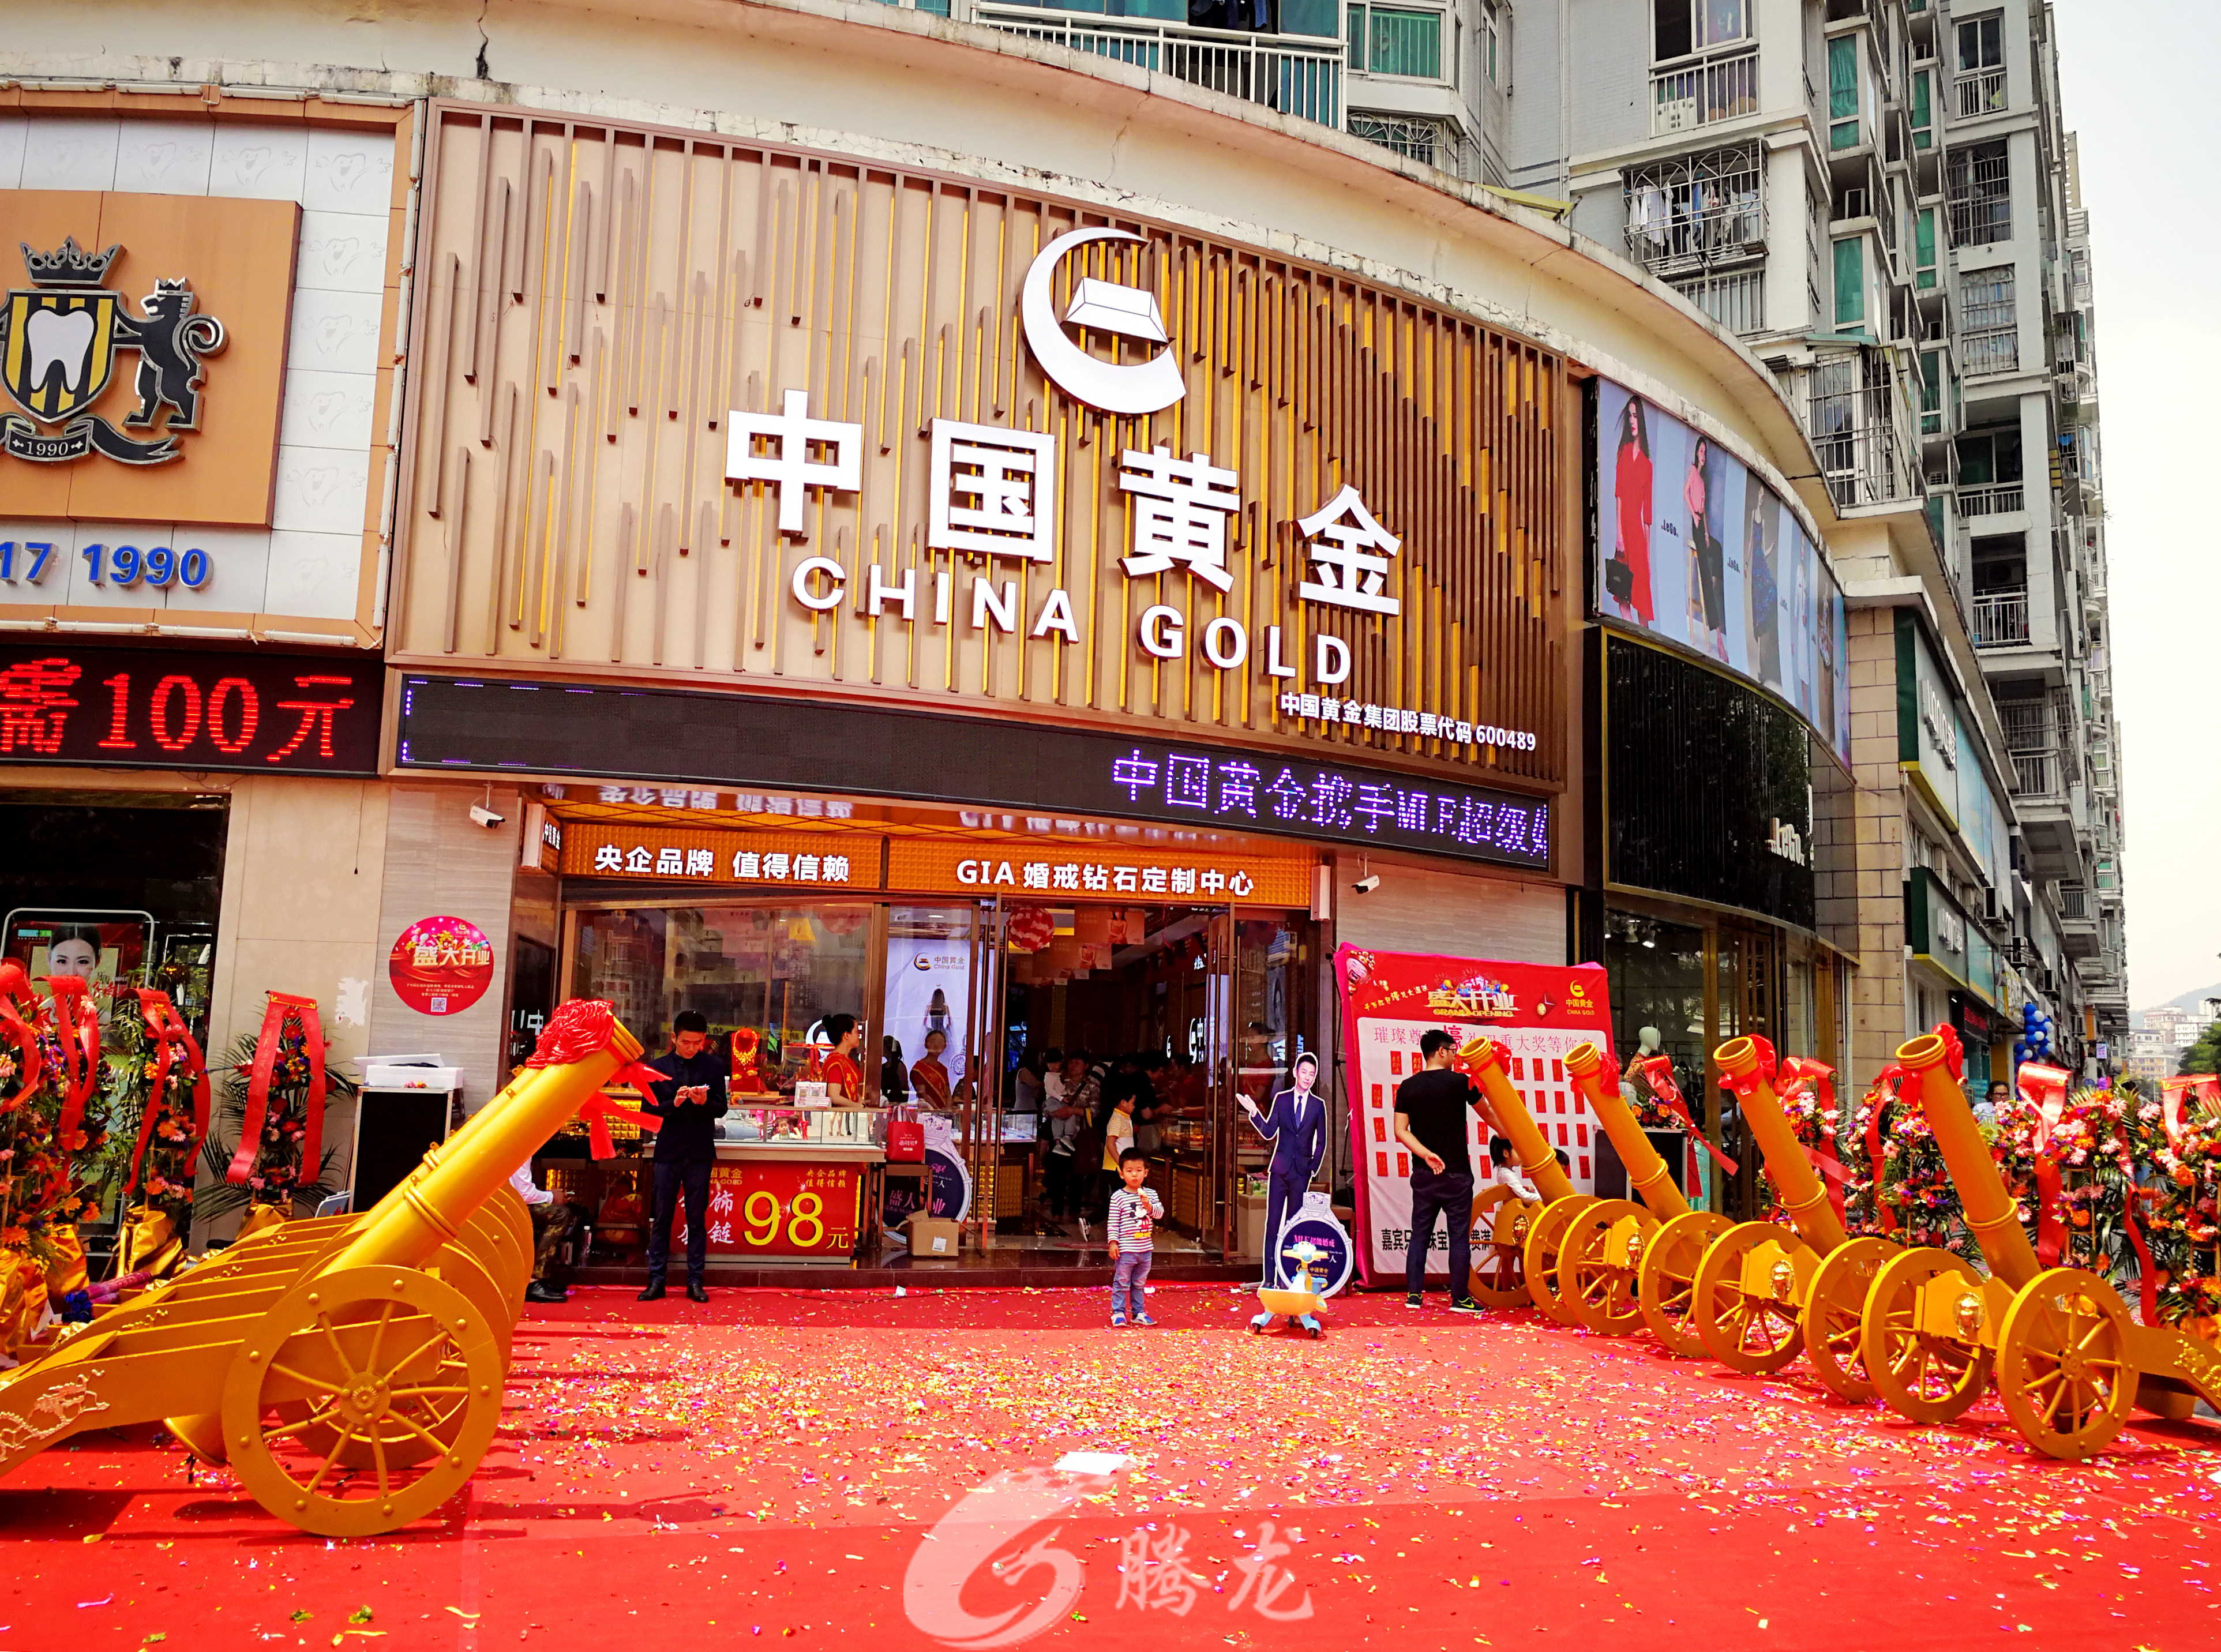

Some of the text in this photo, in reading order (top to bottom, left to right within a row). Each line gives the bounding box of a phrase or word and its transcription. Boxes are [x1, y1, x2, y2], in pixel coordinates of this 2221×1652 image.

[25, 441, 69, 456] 1990
[725, 389, 1401, 616] 中国黄金
[82, 543, 210, 588] 1990
[791, 555, 1352, 685] CHINA GOLD
[1281, 693, 1536, 752] 中国黄金集团股票代码 600489
[595, 844, 850, 883] 央企品牌 值得信赖
[956, 859, 1255, 897] GIA 婚戒钻石定制中心
[412, 945, 490, 967] 盛大开业
[934, 955, 965, 964] 中国黄金
[1425, 989, 1521, 1013] 盛大开业
[1566, 998, 1594, 1008] 中国黄金
[710, 1167, 742, 1178] 国黄金
[806, 1169, 847, 1177] 央企品牌
